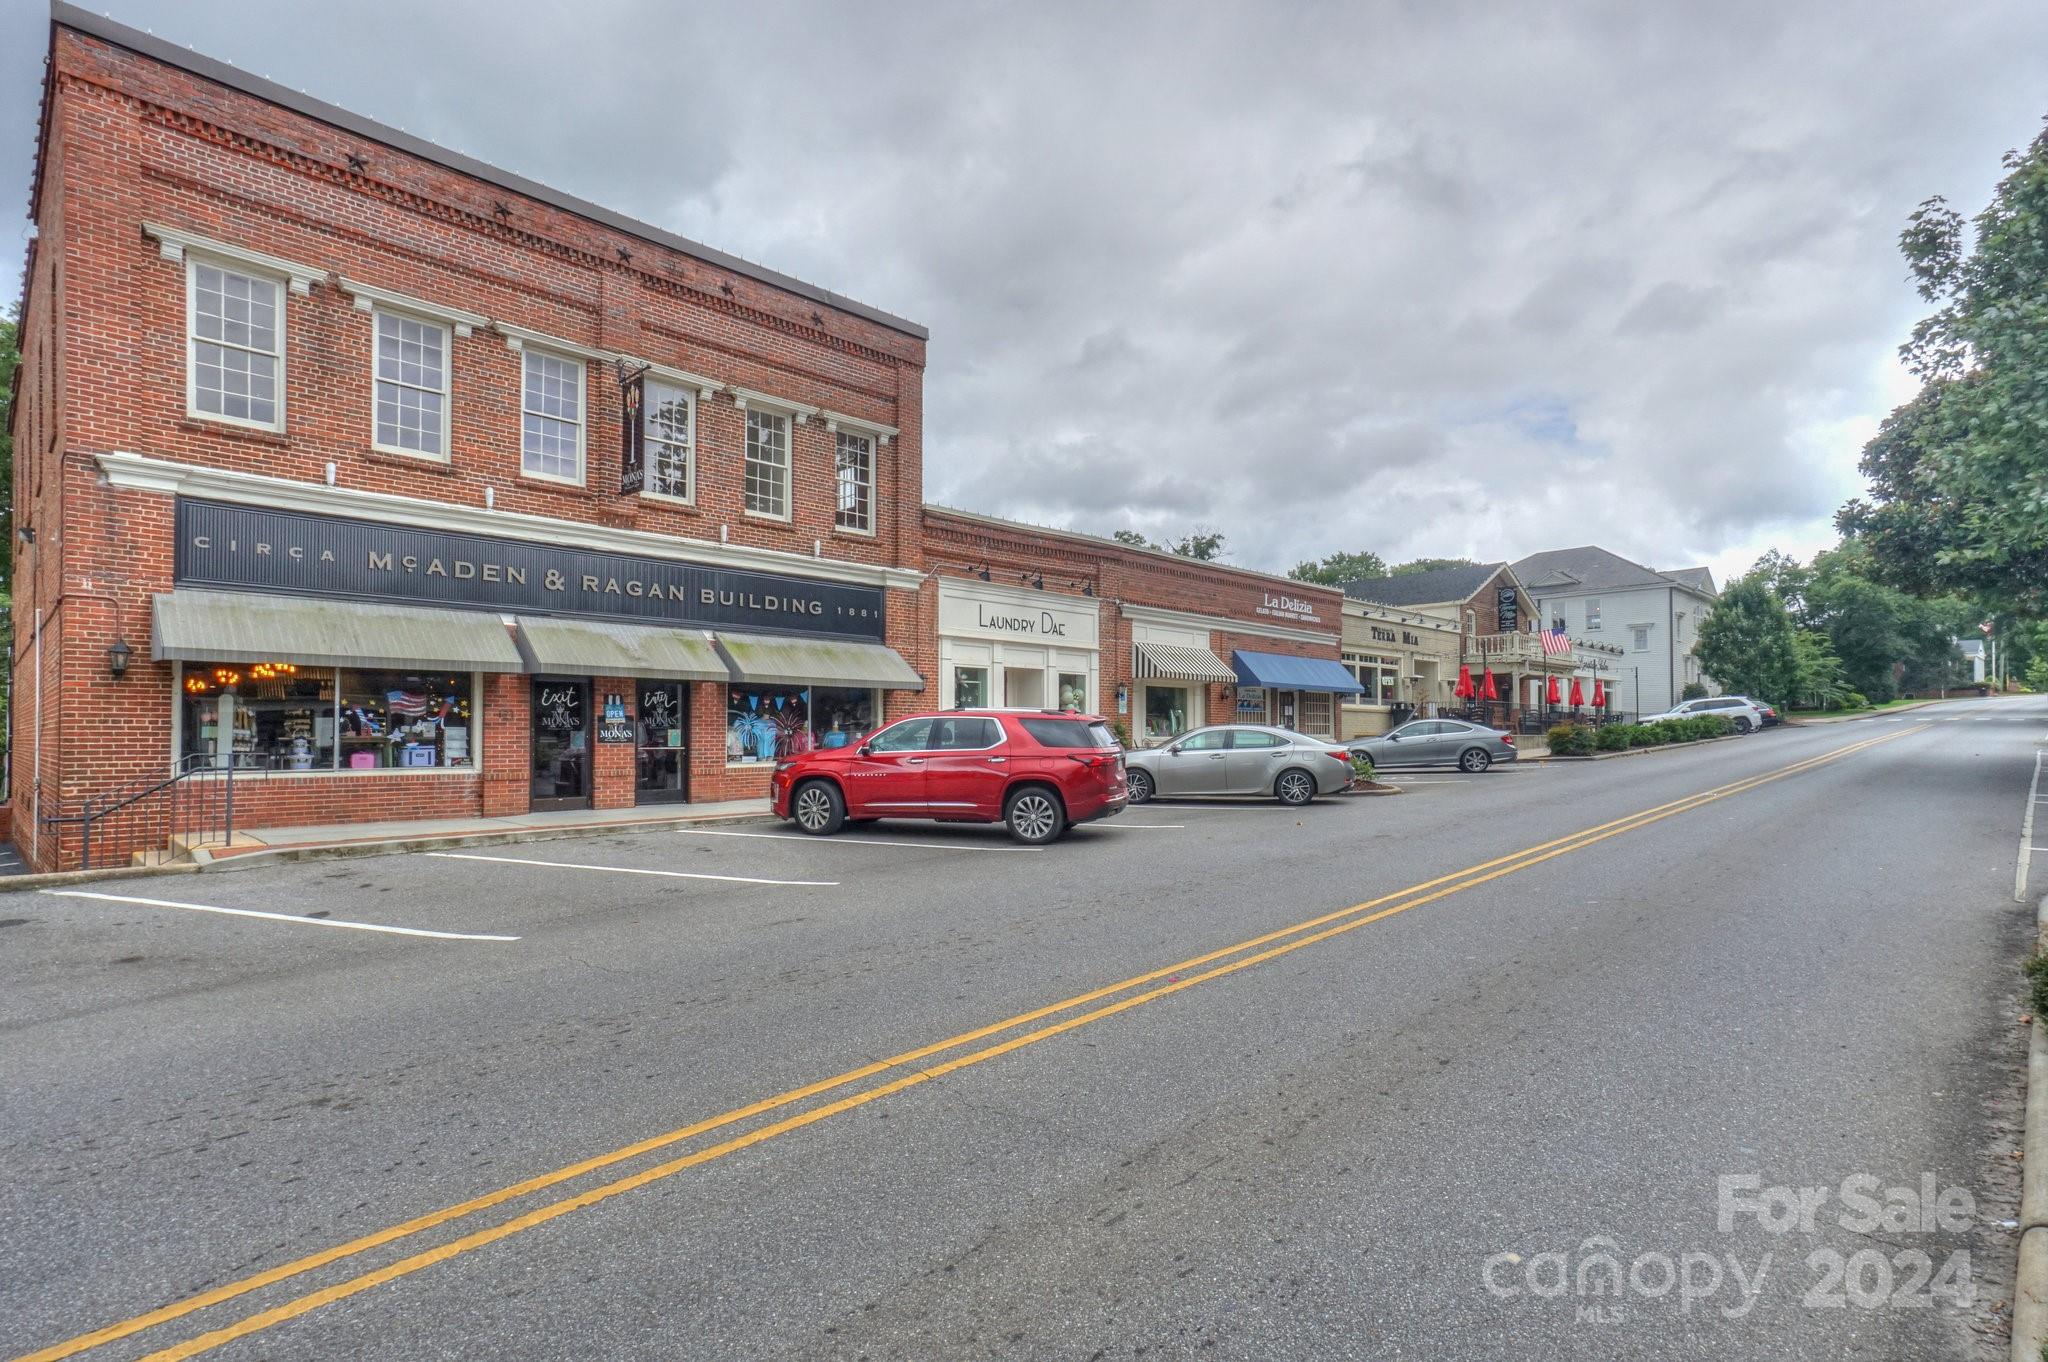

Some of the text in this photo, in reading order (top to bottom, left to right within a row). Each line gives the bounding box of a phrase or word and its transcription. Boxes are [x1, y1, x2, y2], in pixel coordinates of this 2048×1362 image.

[545, 569, 565, 591] &
[582, 575, 684, 601] RAGAN
[700, 588, 822, 615] BUILDING
[837, 606, 878, 619] 1881
[1264, 593, 1313, 614] La Delizia
[979, 604, 1065, 636] LAUNDRY DAE
[1371, 627, 1419, 645] TERRA MIA
[542, 686, 578, 707] Exit
[644, 691, 677, 707] Enter
[606, 710, 624, 718] OPEN
